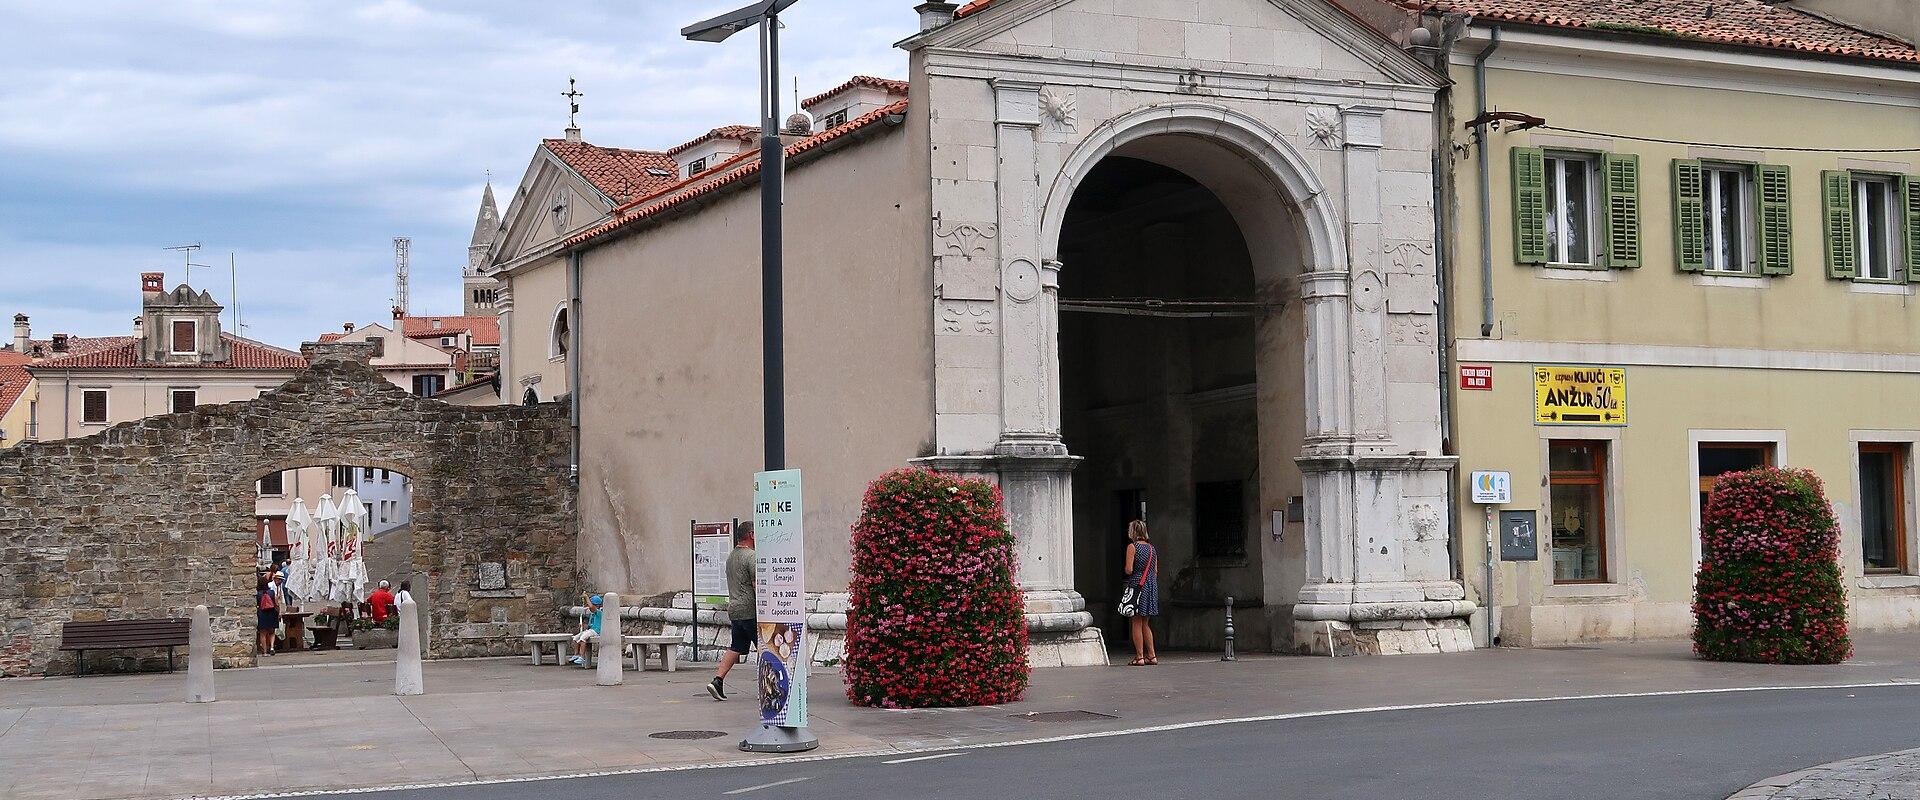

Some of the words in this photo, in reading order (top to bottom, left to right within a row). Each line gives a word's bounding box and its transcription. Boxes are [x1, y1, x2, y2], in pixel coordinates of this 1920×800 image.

[1574, 369, 1605, 383] KLJUČI
[1545, 385, 1593, 407] ANŽUR
[1594, 386, 1611, 409] 50
